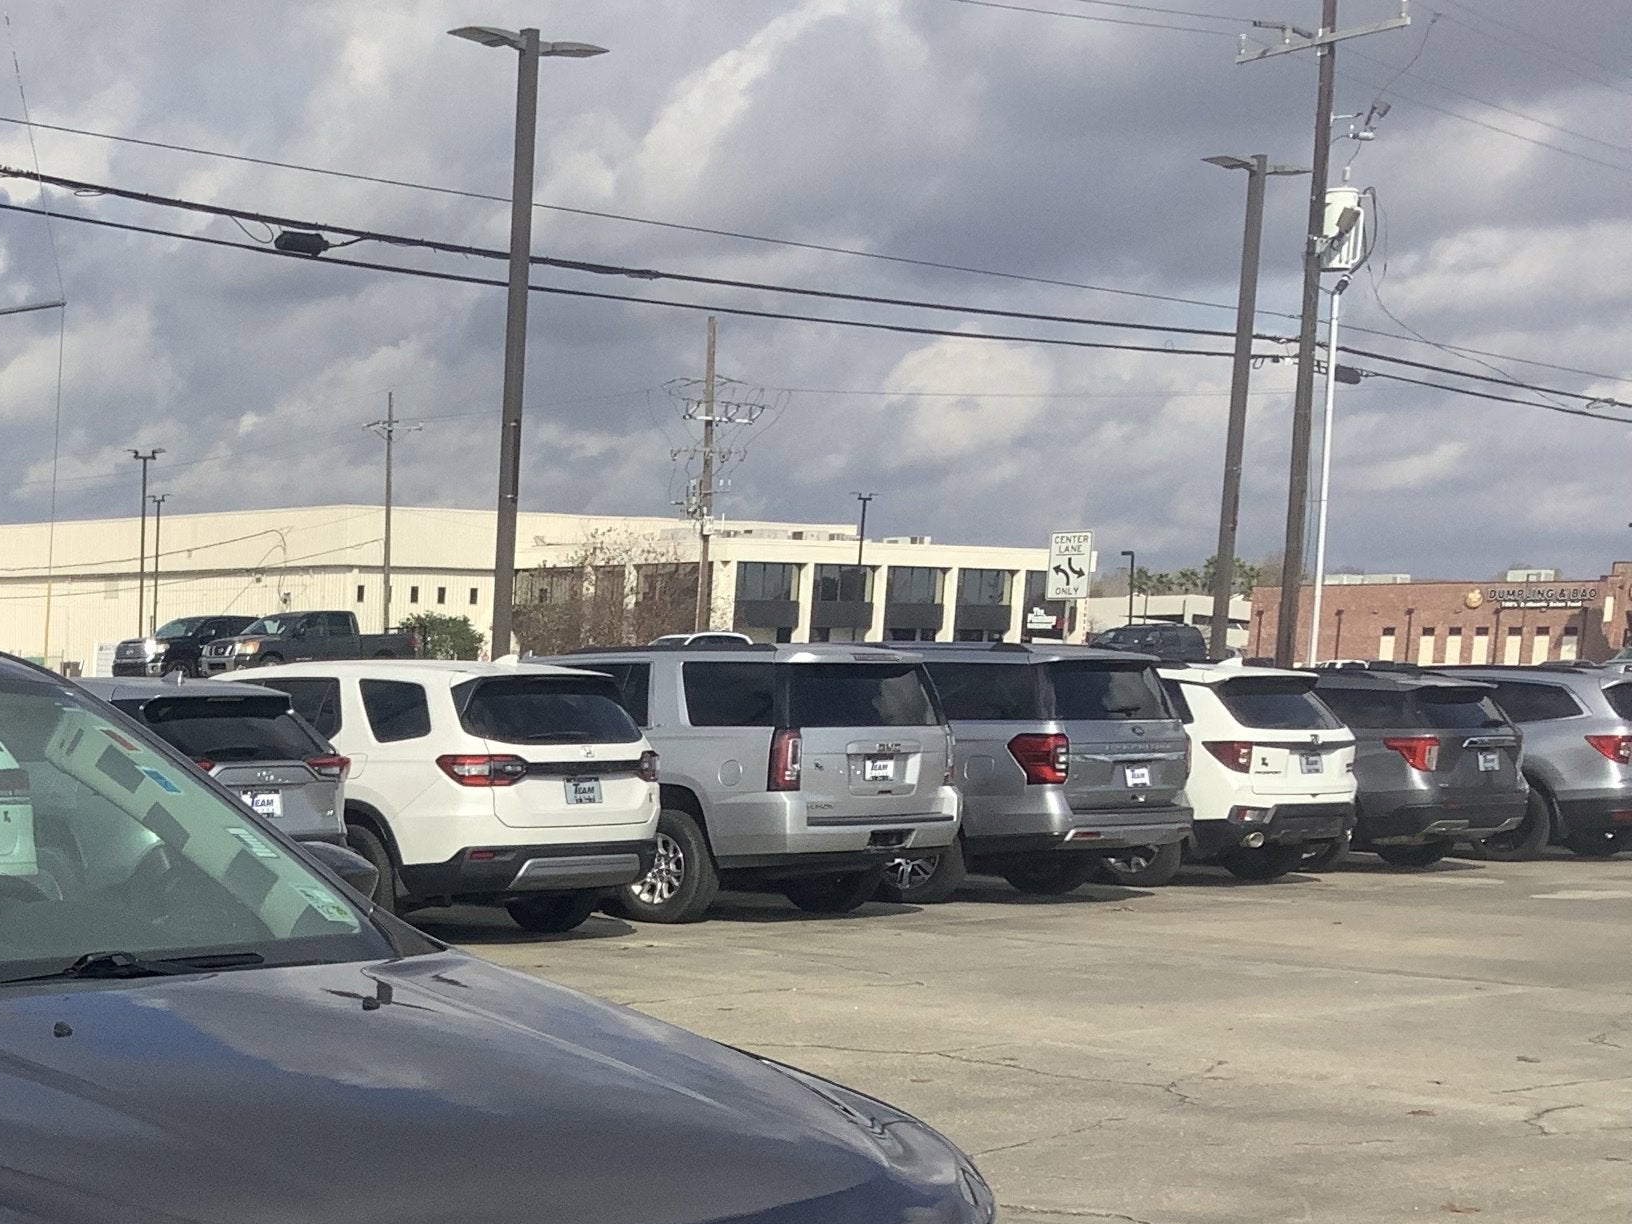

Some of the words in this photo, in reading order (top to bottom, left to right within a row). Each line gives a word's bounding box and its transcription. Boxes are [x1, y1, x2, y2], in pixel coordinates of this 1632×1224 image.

[1054, 535, 1089, 544] CENTER
[1058, 545, 1082, 553] LANE
[1055, 587, 1079, 595] ONLY
[1558, 588, 1567, 599] &
[1570, 588, 1598, 599] BAO
